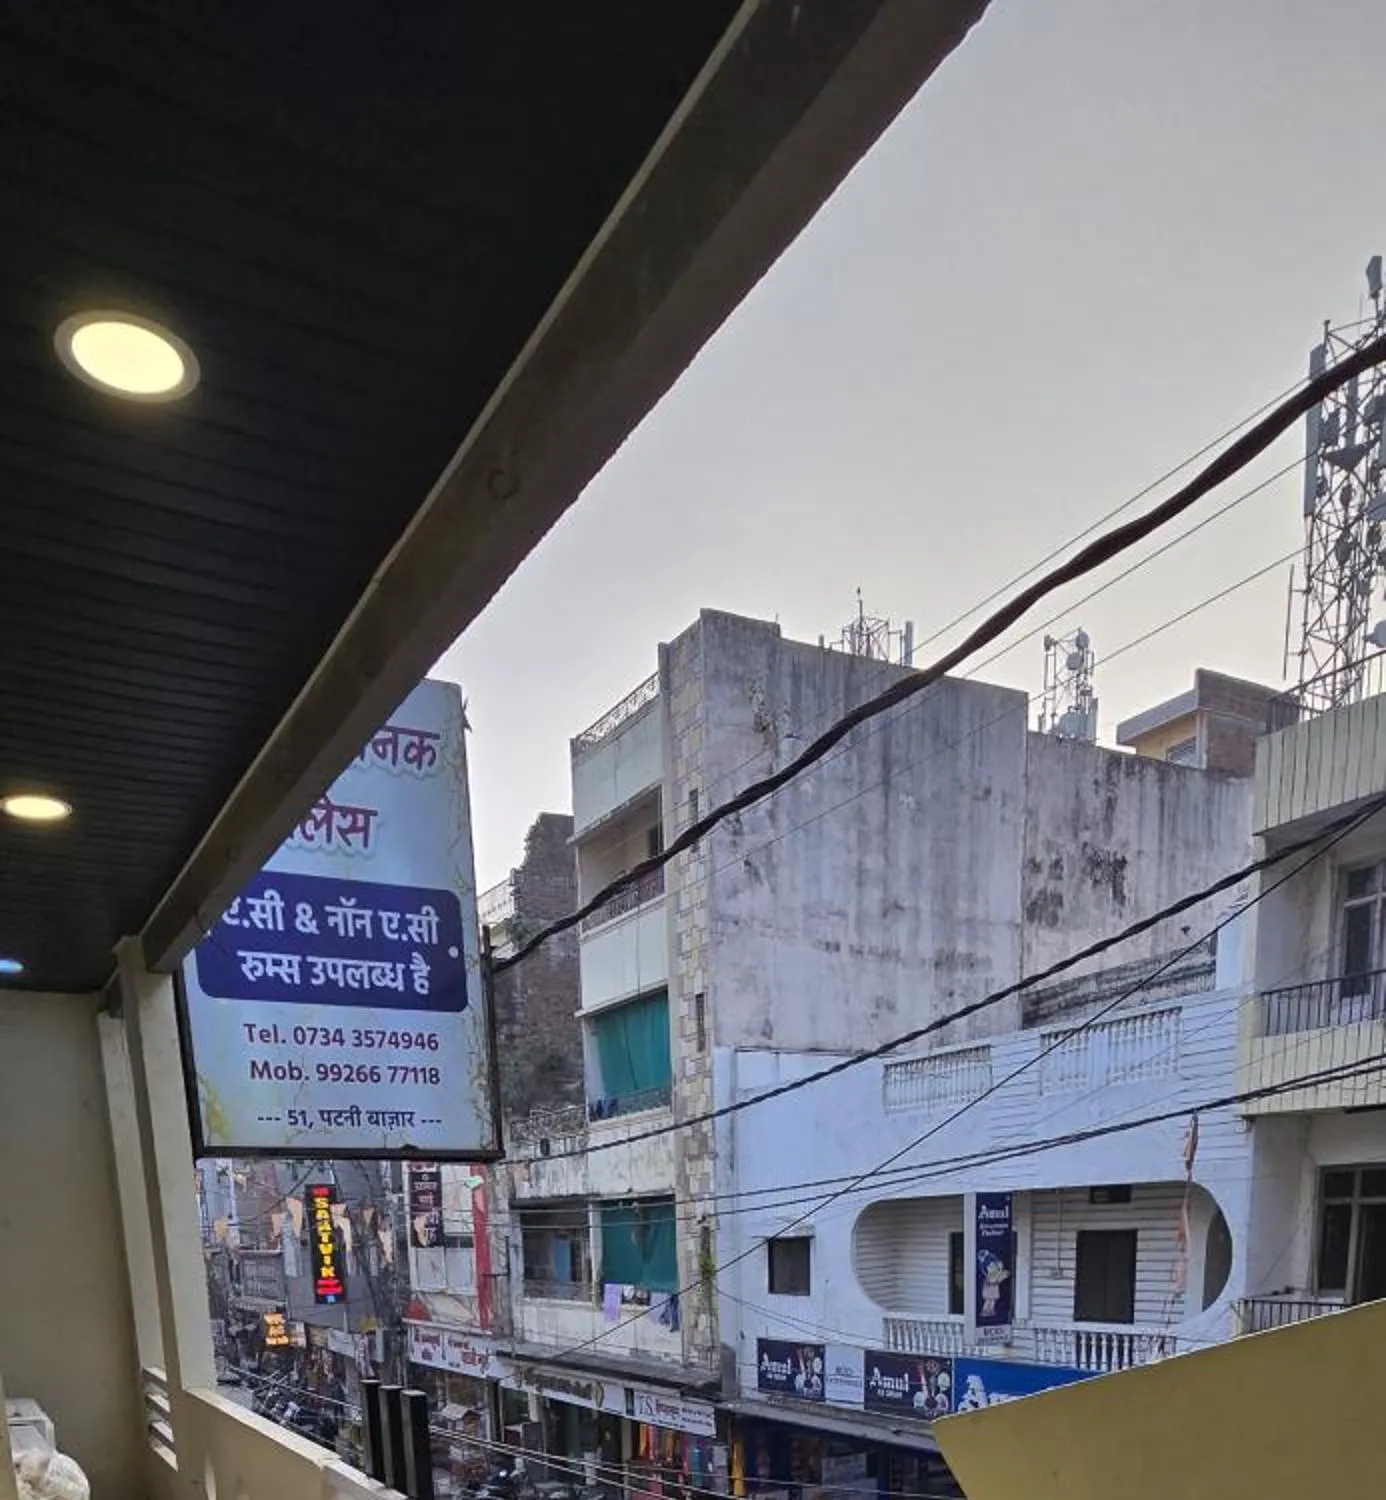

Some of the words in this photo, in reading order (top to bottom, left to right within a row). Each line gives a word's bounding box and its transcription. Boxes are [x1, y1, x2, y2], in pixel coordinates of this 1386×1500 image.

[360, 726, 440, 770] नक
[289, 794, 378, 848] लेस
[295, 903, 320, 934] &
[324, 896, 373, 939] नॉन
[378, 905, 440, 944] ए.सी
[306, 956, 405, 992] उपलब्ध
[410, 952, 431, 994] है
[244, 1023, 286, 1044] Tel.
[293, 1025, 345, 1046] 0734
[352, 1029, 439, 1050] 3574946
[250, 1060, 310, 1081] Mob.
[316, 1063, 381, 1083] 99266
[387, 1065, 441, 1085] 77118
[287, 1109, 314, 1129] 51,
[318, 1105, 361, 1128] पटनी
[760, 1352, 792, 1375] Amul
[869, 1367, 910, 1392] Amul
